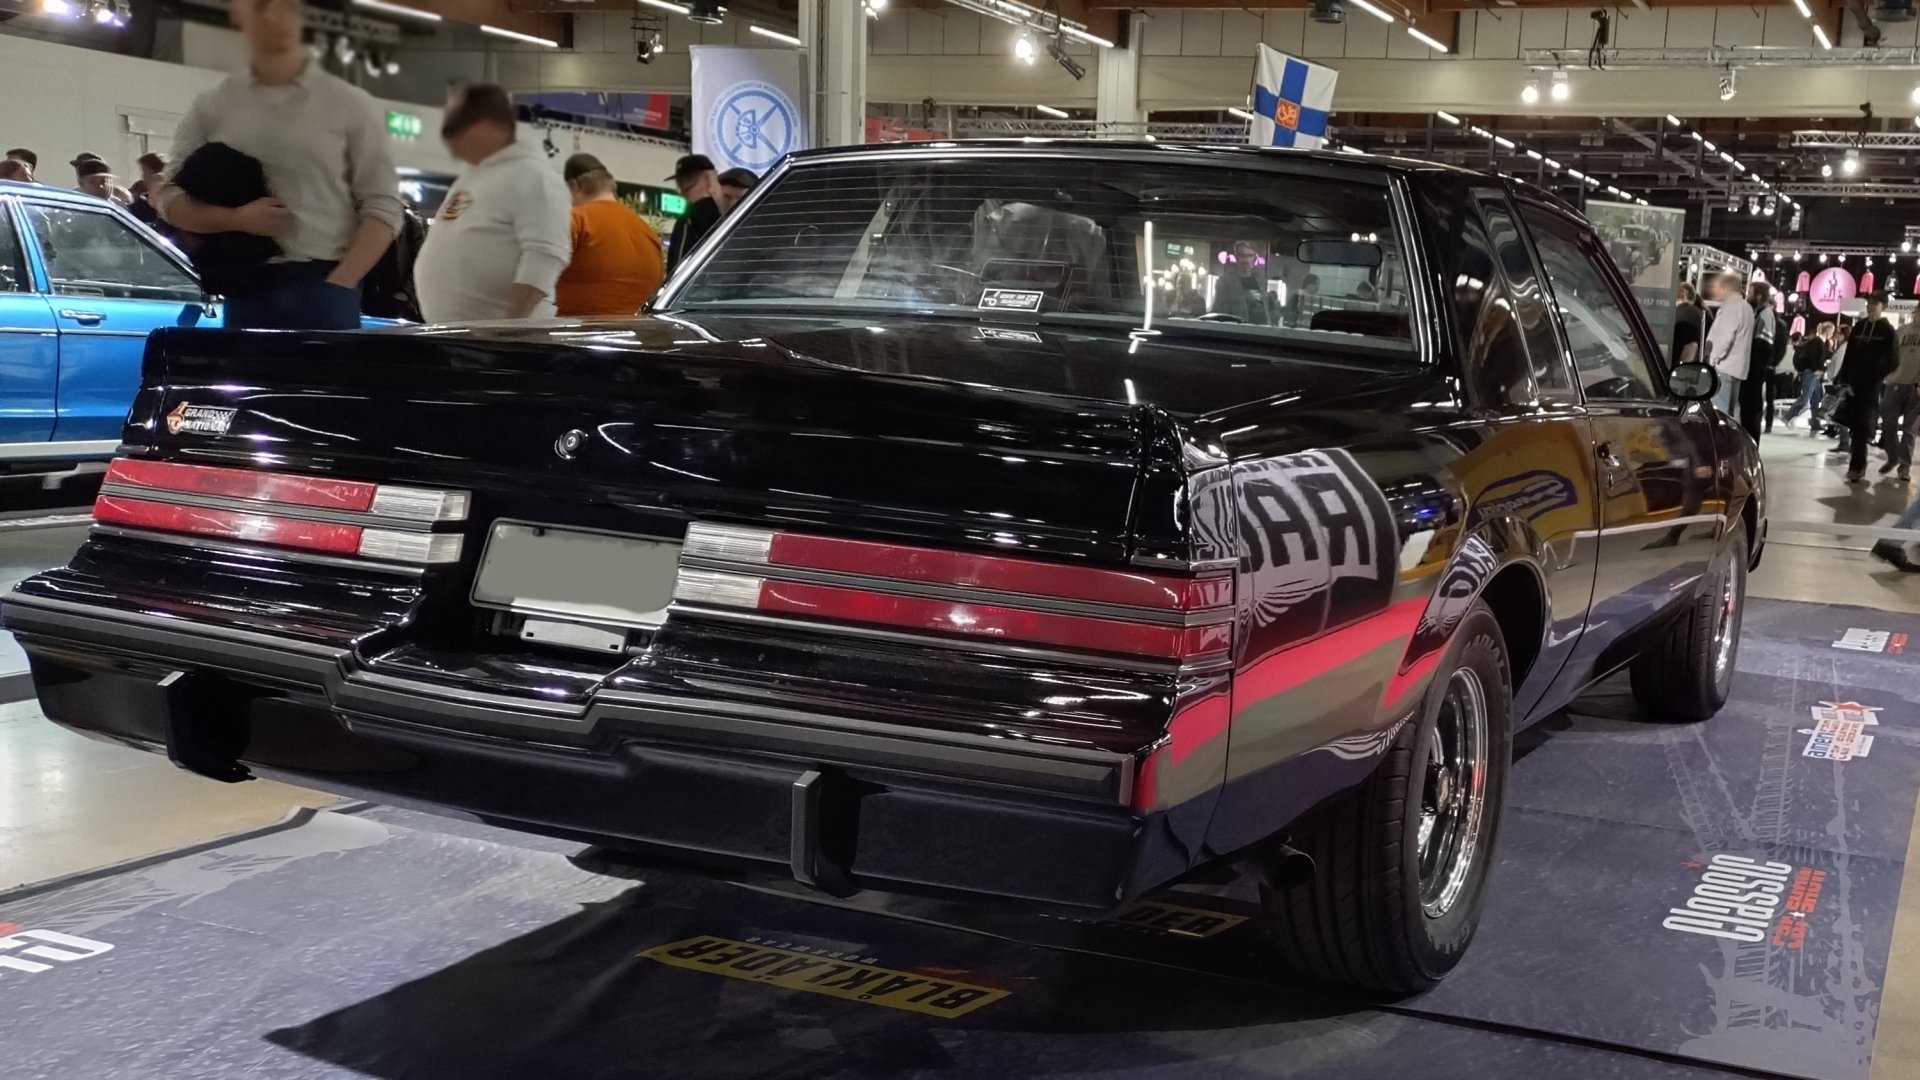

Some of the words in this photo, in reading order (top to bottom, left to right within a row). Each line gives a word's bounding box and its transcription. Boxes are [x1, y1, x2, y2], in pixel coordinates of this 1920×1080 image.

[184, 408, 215, 418] GRAND
[1662, 854, 1792, 943] Classic
[666, 940, 992, 1010] BLÅKLÄDER
